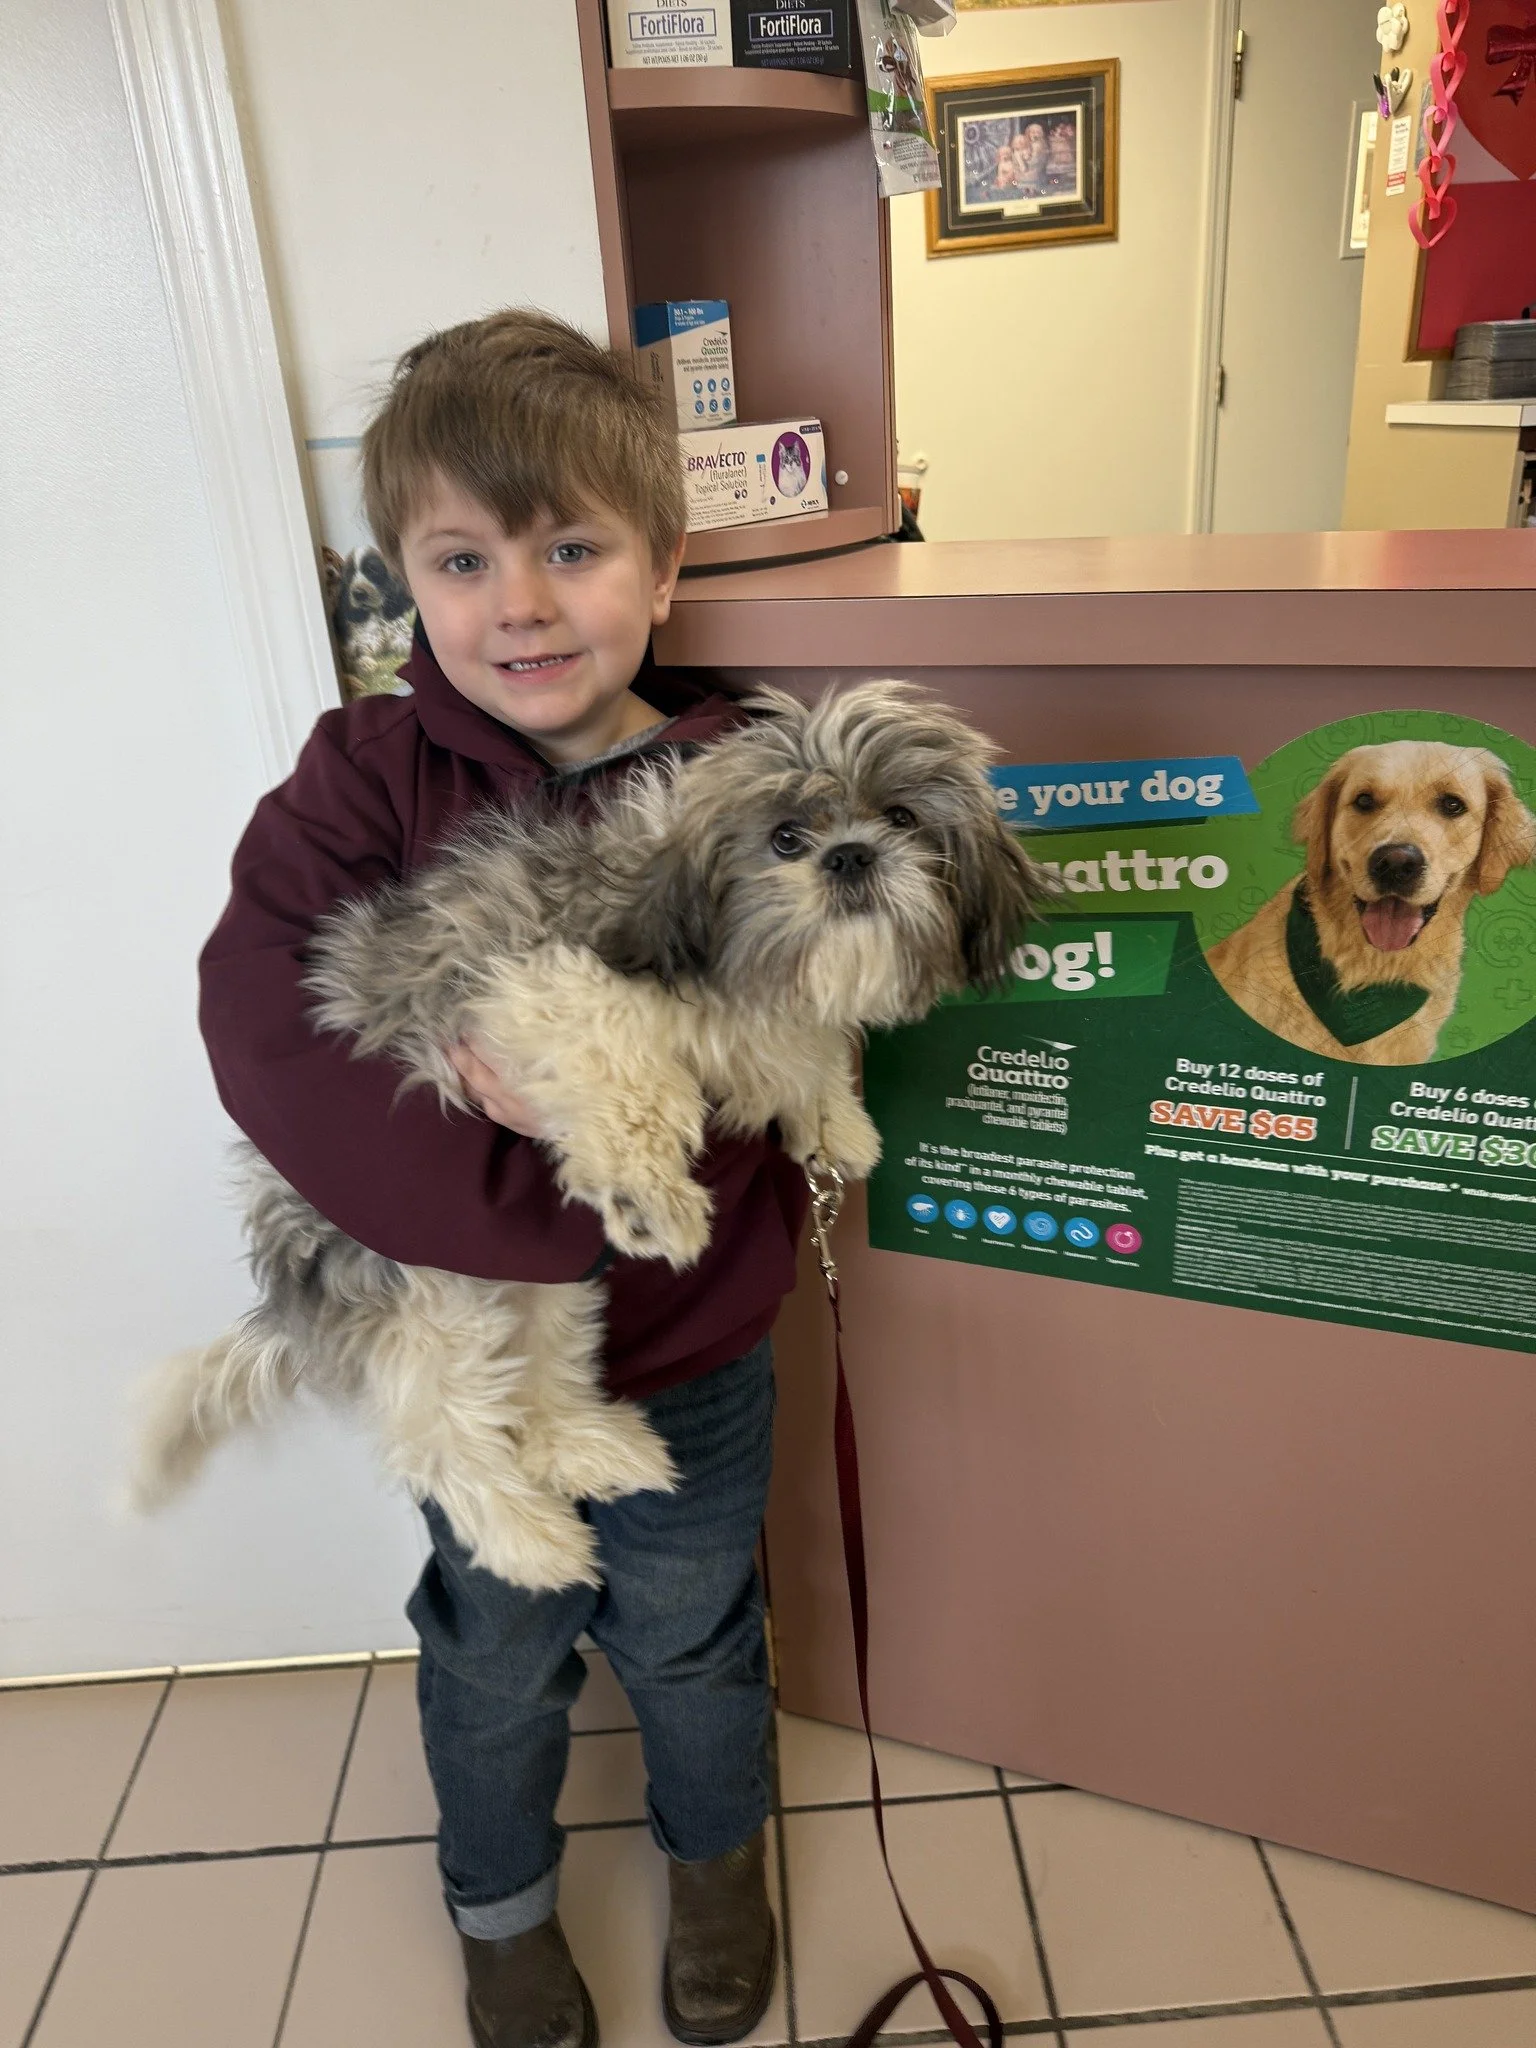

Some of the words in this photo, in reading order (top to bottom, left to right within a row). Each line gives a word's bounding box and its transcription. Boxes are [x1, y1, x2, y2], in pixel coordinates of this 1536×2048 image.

[640, 13, 705, 36] FortiFlora
[760, 15, 822, 37] FortiFlora
[688, 451, 745, 471] BRAVECTO
[720, 479, 748, 491] Solution
[1027, 778, 1130, 816] your
[1140, 769, 1225, 807] dog
[1041, 849, 1229, 893] uattro
[1008, 931, 1116, 992] og!
[977, 1045, 1070, 1071] Credelio
[967, 1062, 1070, 1090] Quattro
[1176, 1058, 1214, 1078] Buy
[1218, 1063, 1241, 1079] 12
[1243, 1066, 1299, 1085] doses
[1302, 1072, 1326, 1087] of
[1164, 1076, 1248, 1099] Credelio
[1250, 1085, 1327, 1107] Quattro
[1409, 1081, 1452, 1102] Buy
[1453, 1087, 1468, 1102] 6
[1471, 1089, 1531, 1109] doses
[1150, 1100, 1247, 1134] SAVE
[1249, 1109, 1318, 1141] $65
[1390, 1101, 1479, 1124] Credelio
[1370, 1125, 1478, 1161] SAVE
[939, 1144, 960, 1157] the
[1016, 1157, 1068, 1172] parasite
[1069, 1165, 1136, 1181] protection
[1144, 1144, 1178, 1158] Plus
[1178, 1151, 1206, 1163] get
[1206, 1154, 1219, 1164] a
[1291, 1163, 1330, 1177] with
[1330, 1169, 1370, 1182] your
[921, 1175, 972, 1192] covering
[973, 1181, 1008, 1195] these
[992, 1169, 1043, 1186] monthly
[1044, 1175, 1105, 1193] chewable
